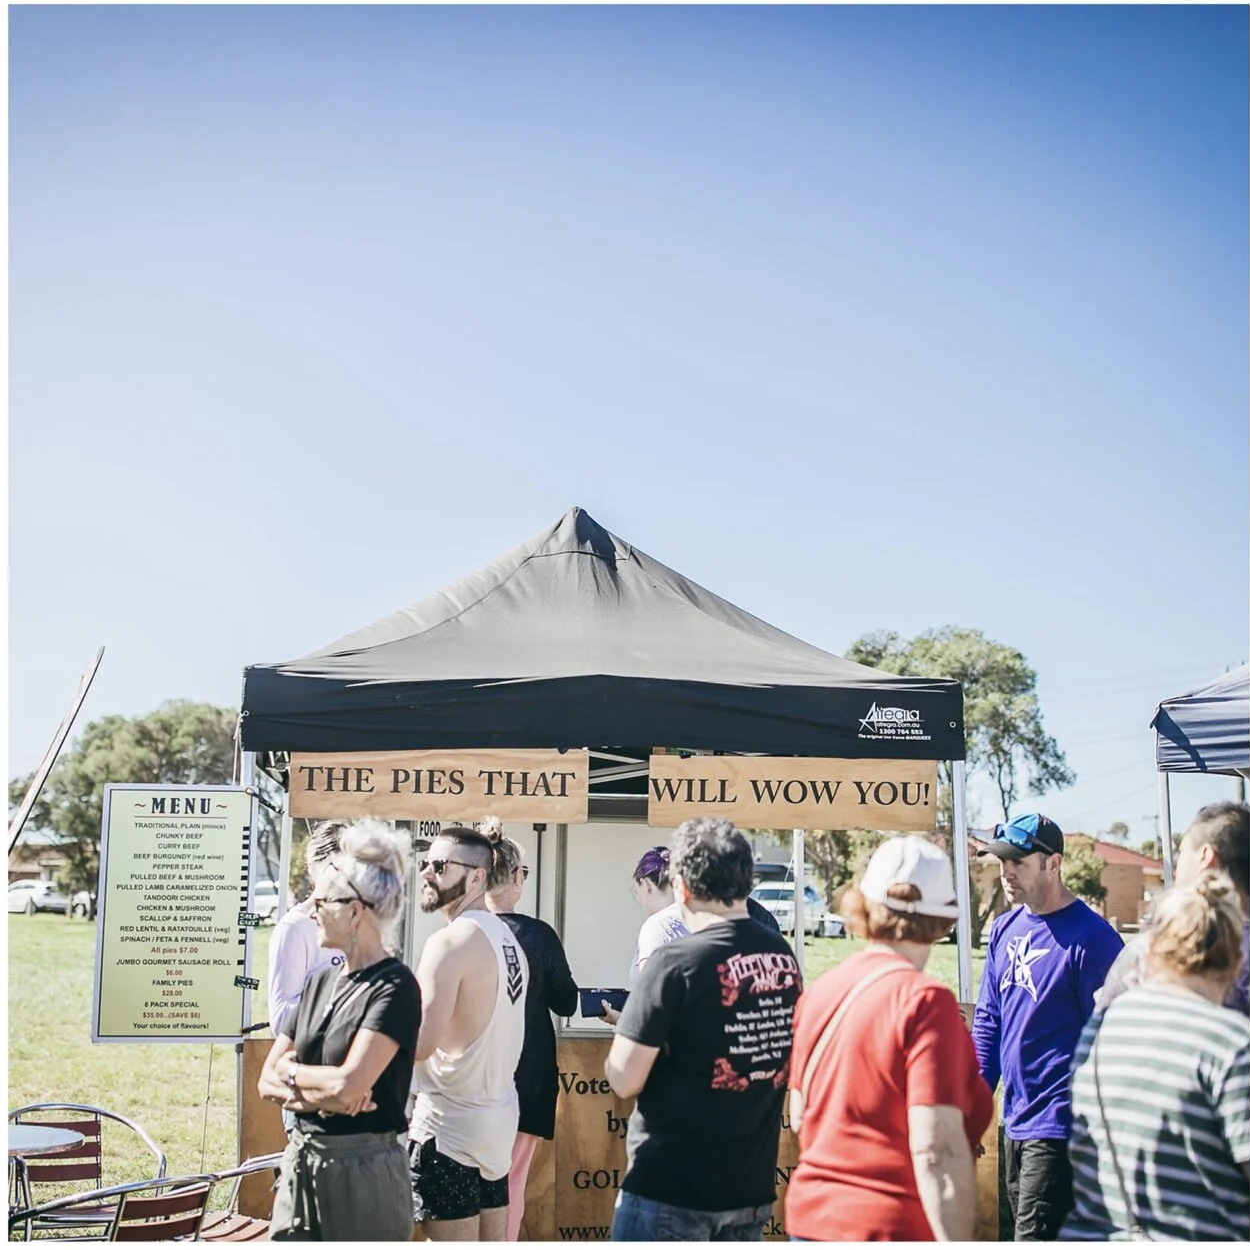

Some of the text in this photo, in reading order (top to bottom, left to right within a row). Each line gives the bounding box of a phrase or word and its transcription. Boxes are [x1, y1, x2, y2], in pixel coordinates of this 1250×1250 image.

[299, 765, 576, 798] THE PIES THAT
[649, 778, 930, 806] WILL WOW YOU!
[150, 797, 211, 814] MENU
[134, 822, 179, 830] TRADITIONAL
[180, 822, 201, 830] PLAIN
[420, 821, 441, 837] FOOD
[133, 853, 151, 861] BEEF
[153, 853, 191, 861] BURGUNDY
[120, 925, 134, 933] RED
[136, 925, 160, 933] LENTIL
[167, 925, 213, 933] RATATOUILLE
[120, 936, 151, 944] SPINACH
[156, 936, 173, 944] FETA
[150, 946, 198, 955] All pies $7.00
[150, 1001, 169, 1009] PACK
[170, 1001, 199, 1009] SPECIAL
[558, 1072, 616, 1095] Vote
